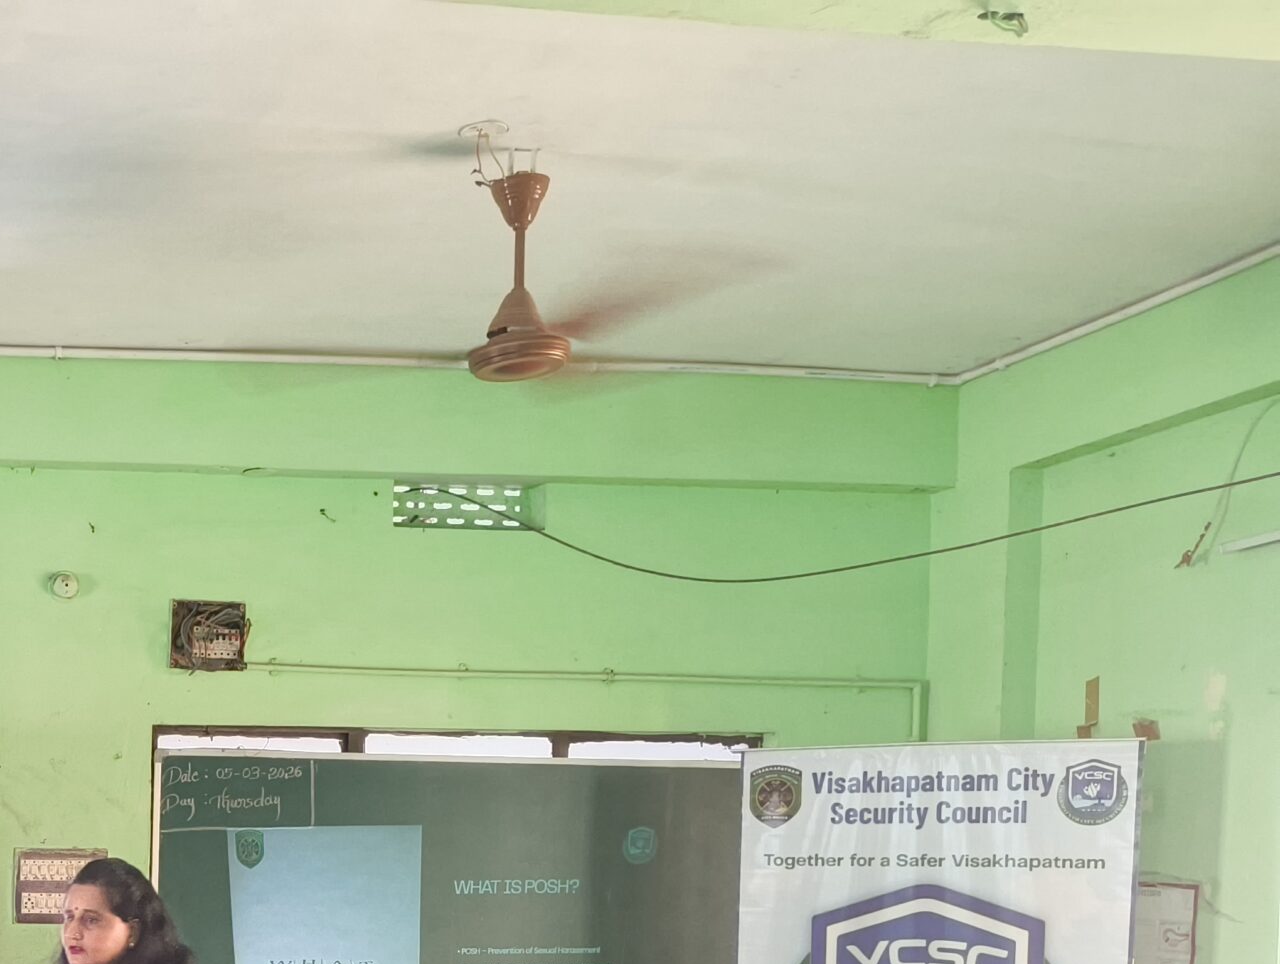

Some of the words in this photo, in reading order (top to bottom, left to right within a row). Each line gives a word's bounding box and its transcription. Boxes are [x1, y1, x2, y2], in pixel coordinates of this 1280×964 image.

[812, 771, 998, 798] Visakhapatnam
[1007, 767, 1055, 797] City
[1074, 771, 1113, 781] VCSC
[830, 801, 928, 830] Security
[936, 800, 1028, 825] Council
[764, 853, 844, 871] Together
[850, 853, 875, 869] for
[880, 857, 891, 869] a
[896, 854, 946, 869] Safer
[952, 854, 1106, 871] Visakhapatnam
[454, 880, 501, 894] WHAT
[504, 880, 521, 894] IS
[525, 879, 580, 894] POSH?
